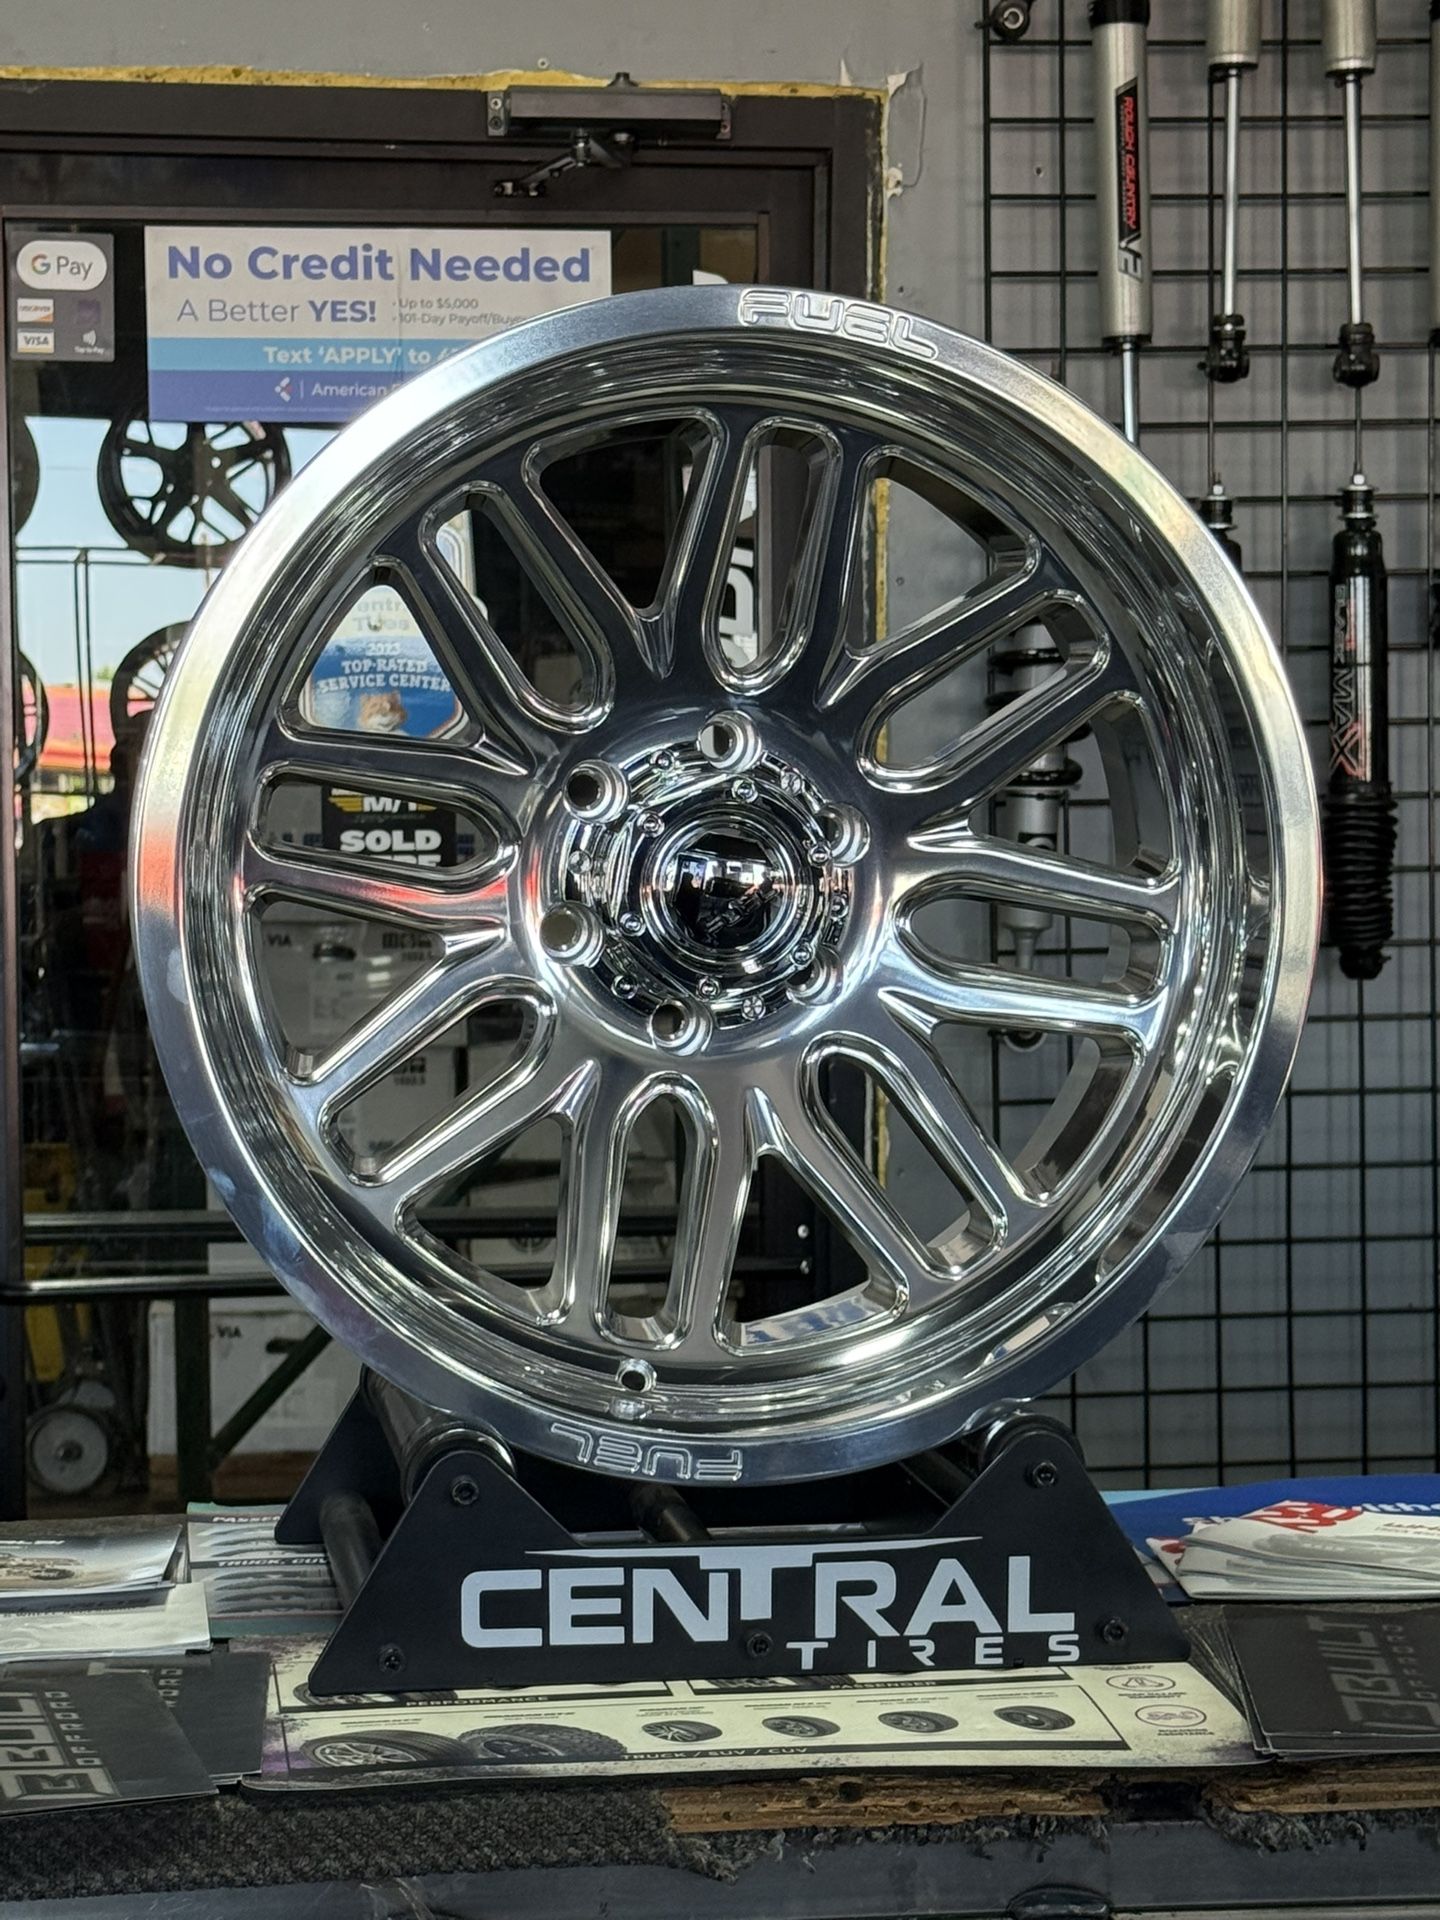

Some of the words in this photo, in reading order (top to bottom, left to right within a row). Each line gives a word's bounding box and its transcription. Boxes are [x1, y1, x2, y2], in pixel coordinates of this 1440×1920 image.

[1123, 96, 1135, 150] ROUGH
[1124, 153, 1136, 230] COUNTRY
[31, 253, 51, 275] G
[56, 256, 93, 281] Pay
[168, 246, 232, 279] No
[247, 243, 395, 281] Credit
[410, 247, 591, 283] Needed
[177, 299, 199, 322] A
[208, 299, 300, 322] Better
[307, 300, 376, 322] YES!
[399, 298, 417, 310] Up
[421, 298, 433, 309] to
[436, 297, 479, 310] $5,000
[23, 335, 49, 346] VISA
[738, 288, 938, 361] FUEL
[263, 346, 313, 364] Text
[408, 348, 432, 365] to
[311, 382, 387, 397] American
[317, 674, 386, 694] SERVICE
[1328, 667, 1368, 783] MAX
[340, 829, 442, 853] SOLD
[551, 1423, 743, 1481] FUEL
[461, 1537, 1075, 1648] CENTRAL
[786, 1633, 1080, 1670] TIRES
[1305, 1614, 1403, 1698] BUILT
[406, 1696, 548, 1706] PERFORMANCE
[44, 1690, 104, 1766] OFFROAD
[621, 1752, 687, 1761] TRUCK
[708, 1749, 746, 1757] SUV
